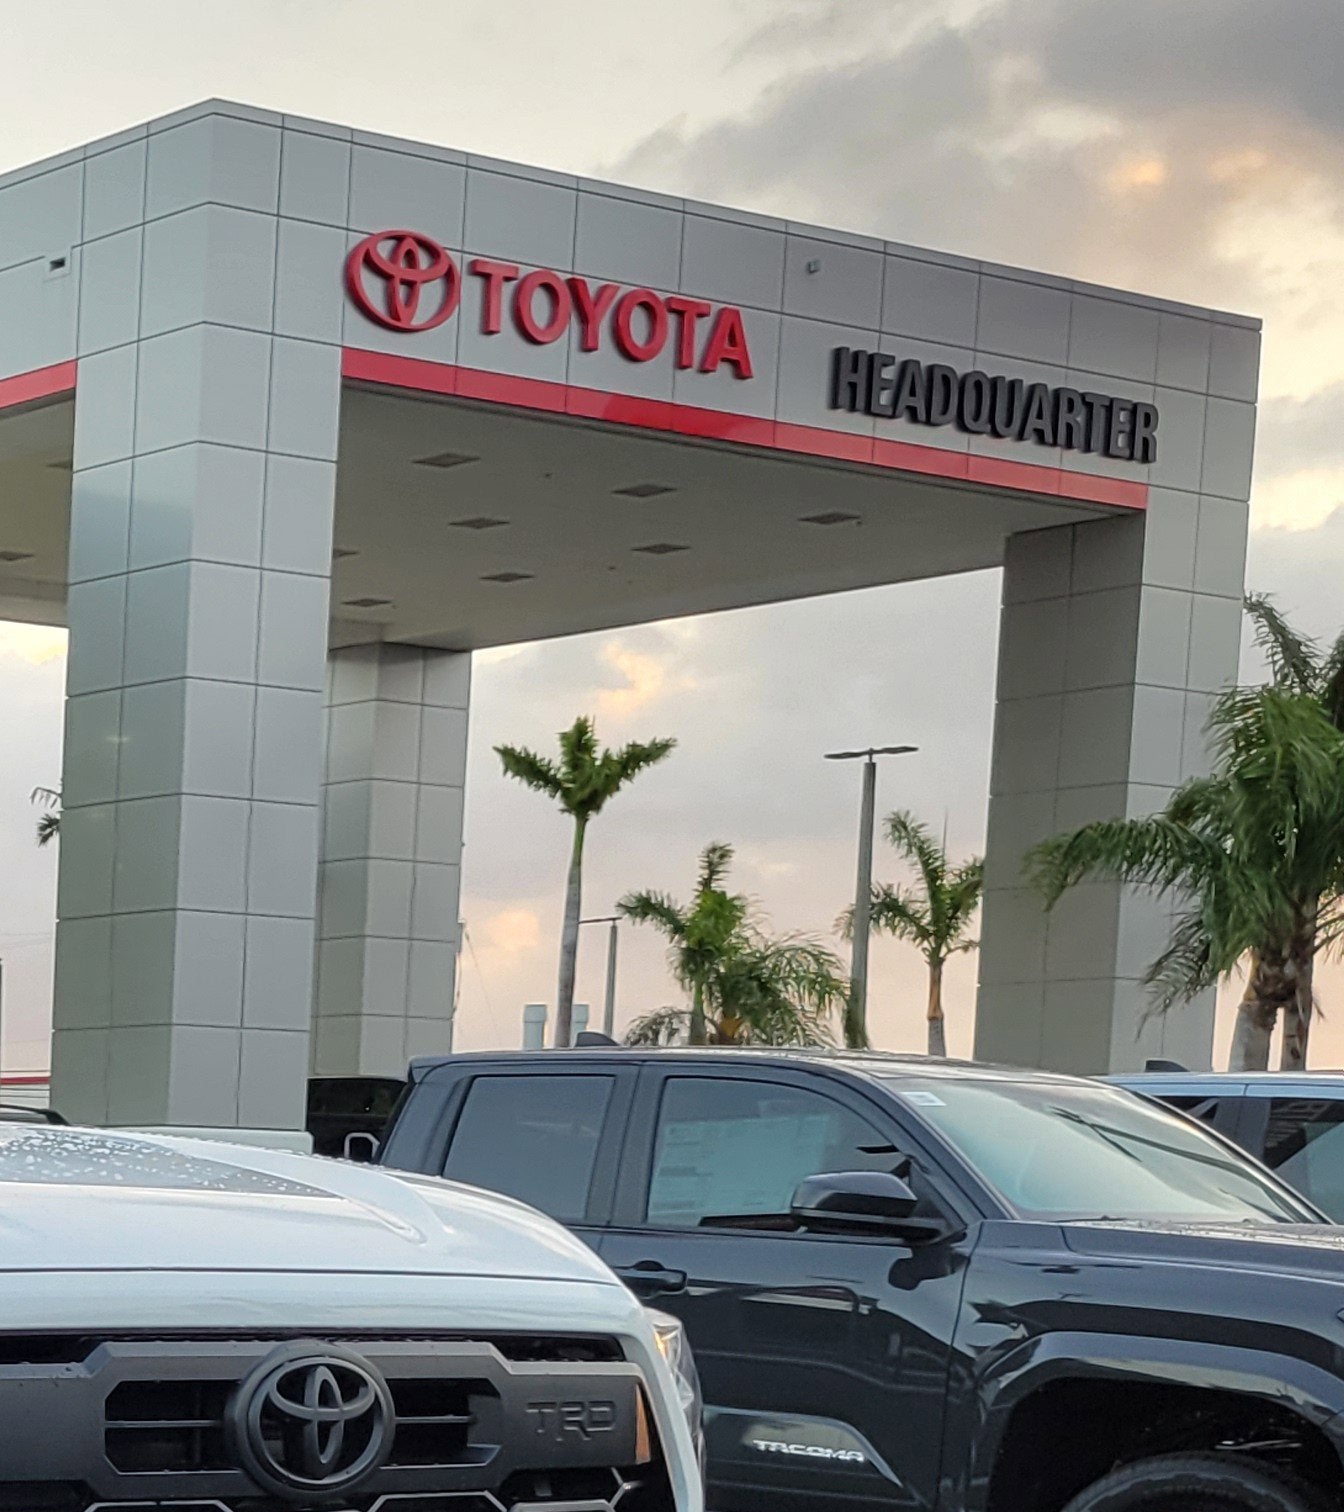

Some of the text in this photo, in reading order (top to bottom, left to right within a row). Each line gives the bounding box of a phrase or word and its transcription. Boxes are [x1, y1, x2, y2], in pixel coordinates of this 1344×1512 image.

[468, 258, 754, 380] TOYOTA
[828, 345, 1158, 464] HEADQUARTER
[525, 1401, 616, 1442] TRD
[752, 1439, 865, 1463] TACOMA
